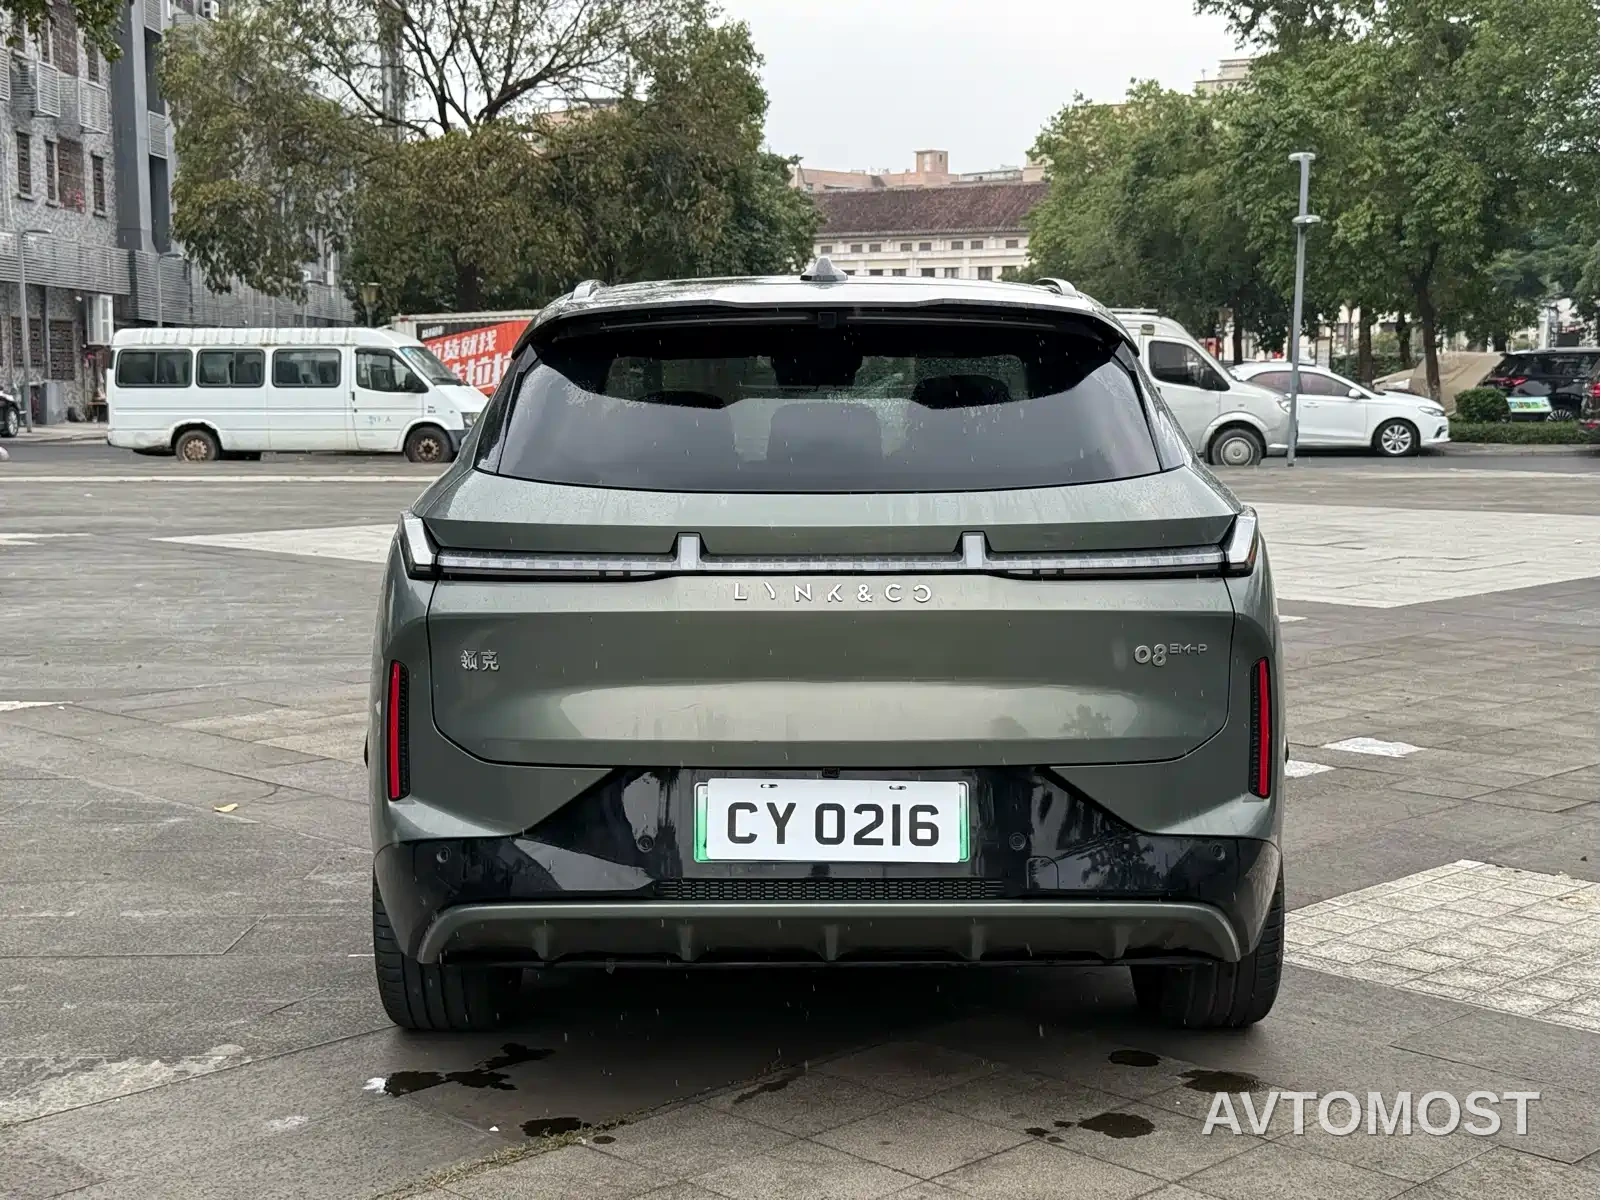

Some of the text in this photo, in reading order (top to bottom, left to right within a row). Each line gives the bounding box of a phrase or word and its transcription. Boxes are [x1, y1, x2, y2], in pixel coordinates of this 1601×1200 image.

[460, 649, 500, 671] 领克
[1134, 643, 1208, 667] 08 EM-P
[727, 802, 940, 847] CY 0216
